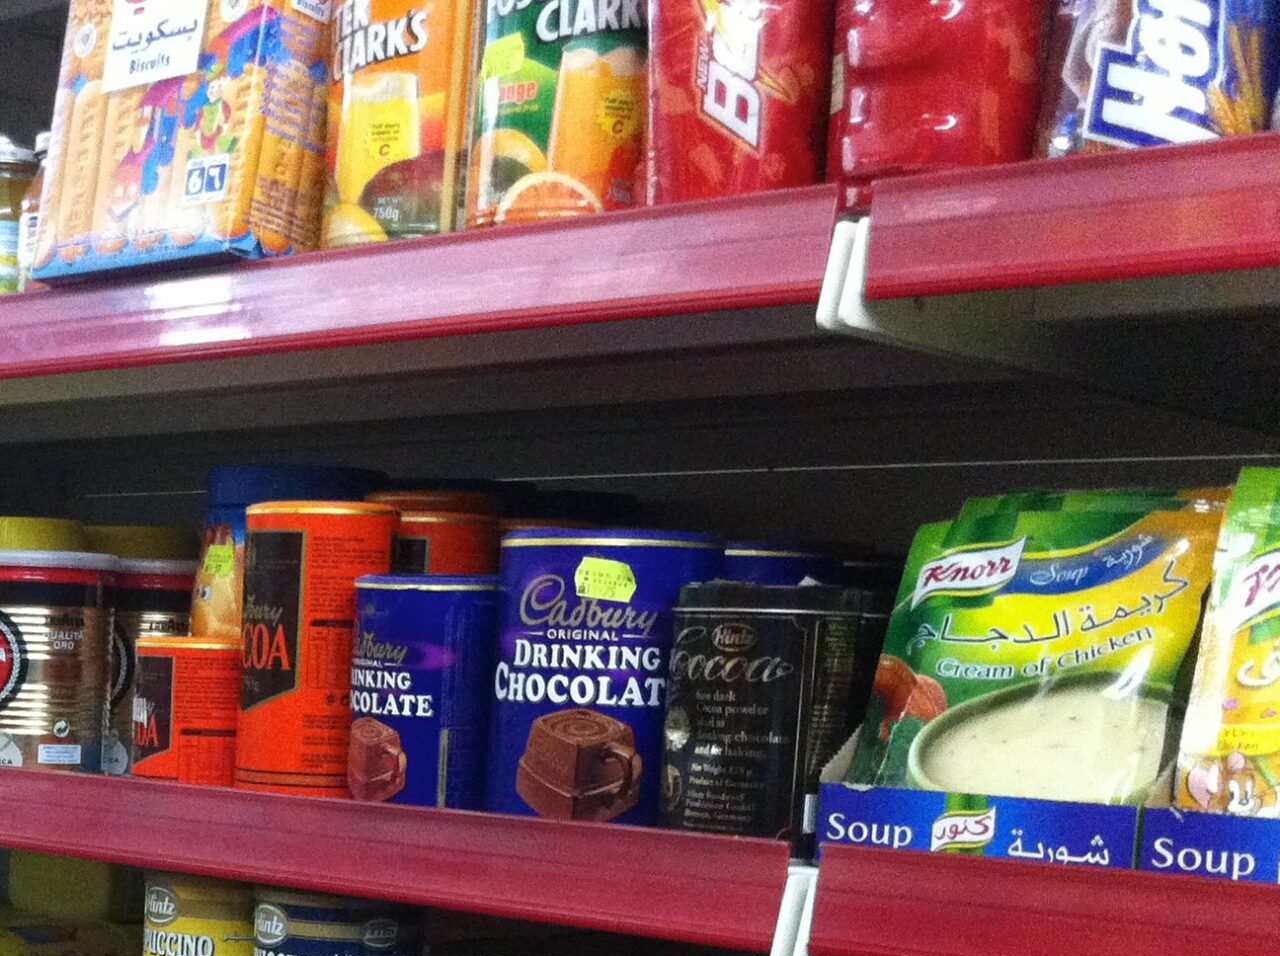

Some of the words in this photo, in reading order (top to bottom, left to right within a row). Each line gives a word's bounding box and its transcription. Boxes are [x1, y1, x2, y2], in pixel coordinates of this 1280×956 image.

[536, 0, 642, 42] CLARK
[128, 53, 171, 75] Biscuits
[921, 556, 1013, 589] Knorr
[1028, 561, 1090, 587] Soup
[1079, 557, 1189, 630] كريمة
[519, 574, 659, 638] Cadbury
[241, 622, 291, 671] COA
[514, 638, 661, 672] DRINKING
[546, 627, 620, 642] ORIGINAL
[906, 610, 1070, 656] الدجاج
[935, 657, 1014, 680] Cream
[1023, 655, 1049, 677] of
[1058, 625, 1154, 670] Chicken
[350, 690, 434, 718] COLATE
[494, 660, 667, 708] CHOCOLAT
[826, 813, 914, 850] Soup
[1007, 828, 1111, 866] شوربة
[1150, 837, 1256, 882] Soup
